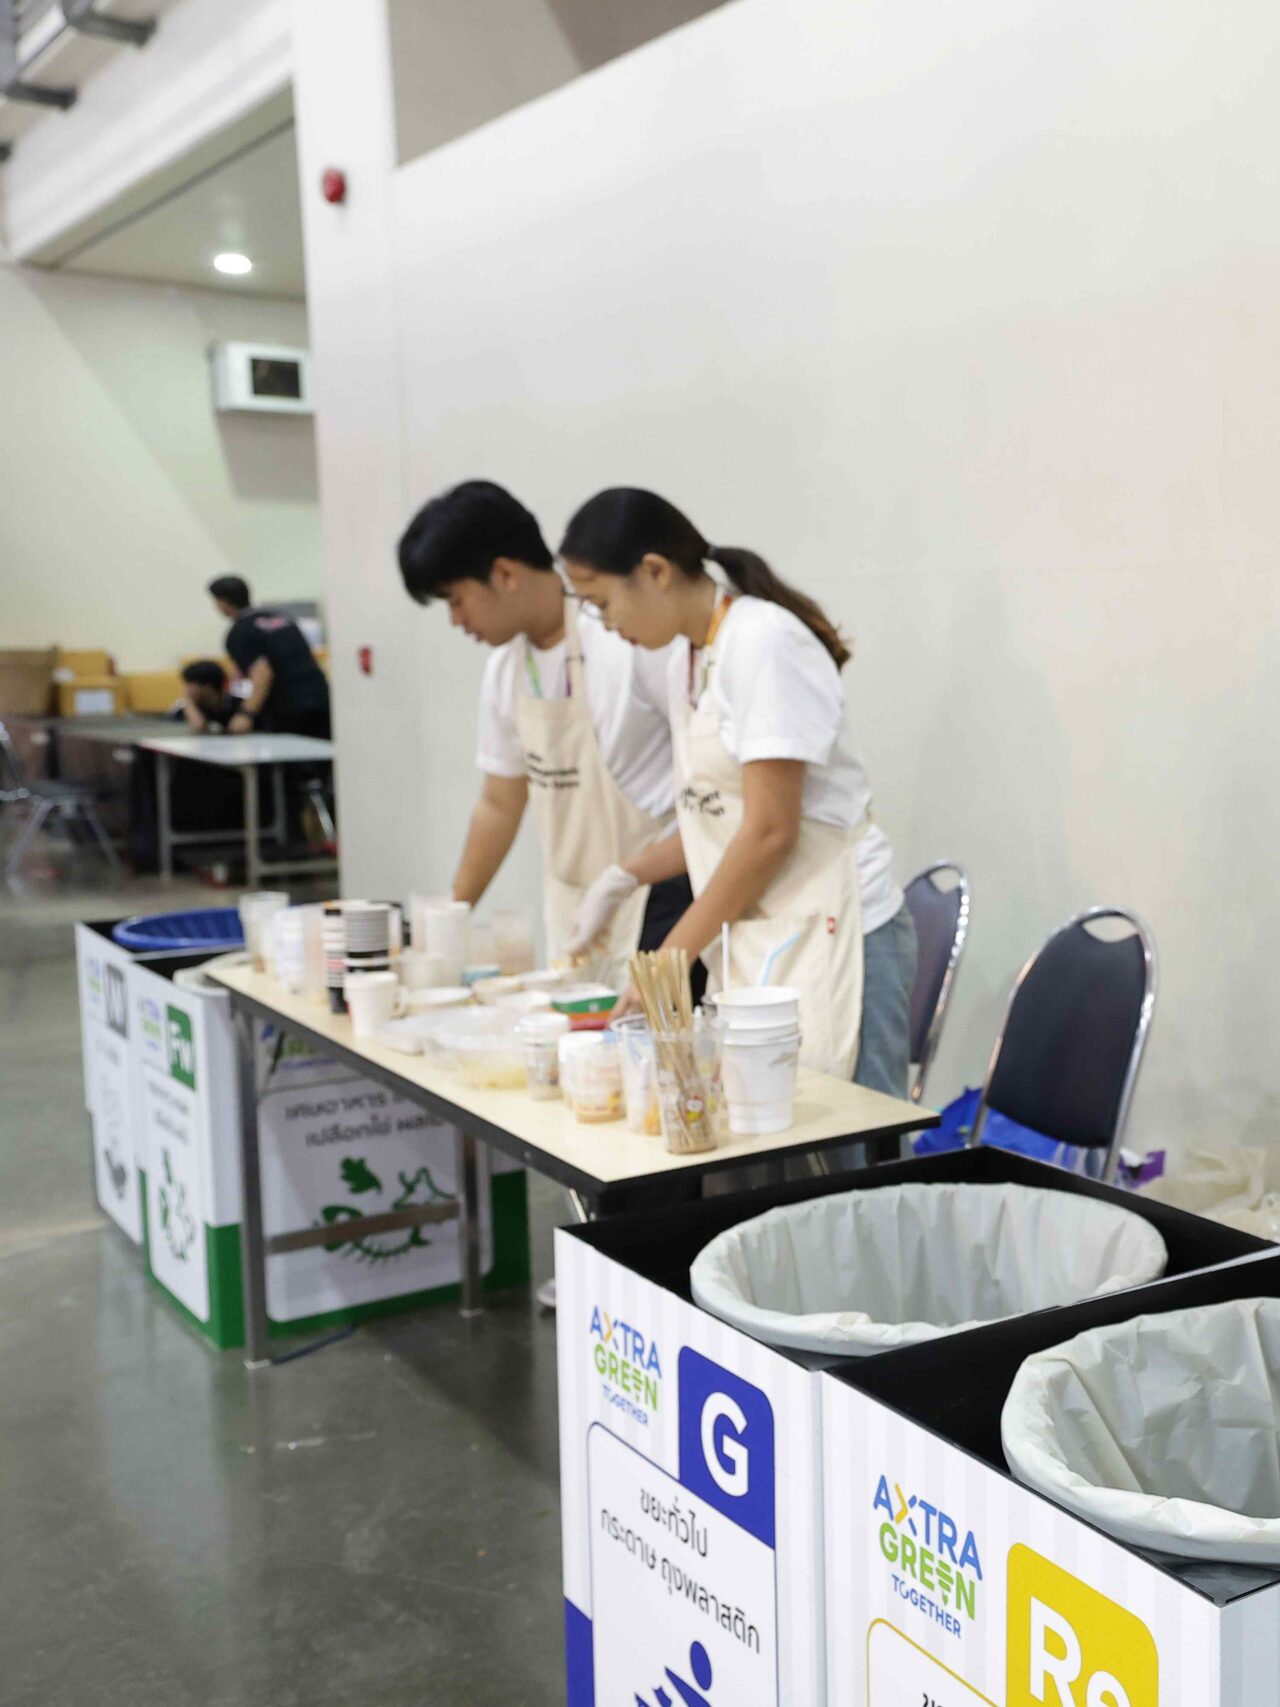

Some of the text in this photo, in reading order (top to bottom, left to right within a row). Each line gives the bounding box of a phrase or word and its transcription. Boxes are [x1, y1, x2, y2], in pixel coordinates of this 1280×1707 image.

[589, 1304, 663, 1380] AXTRA
[594, 1344, 659, 1411] GREEN
[602, 1383, 649, 1427] TOGETHER
[700, 1391, 749, 1498] G
[873, 1474, 983, 1581] AXTRA
[879, 1522, 976, 1620] GREEN
[891, 1573, 962, 1639] TOGETHER
